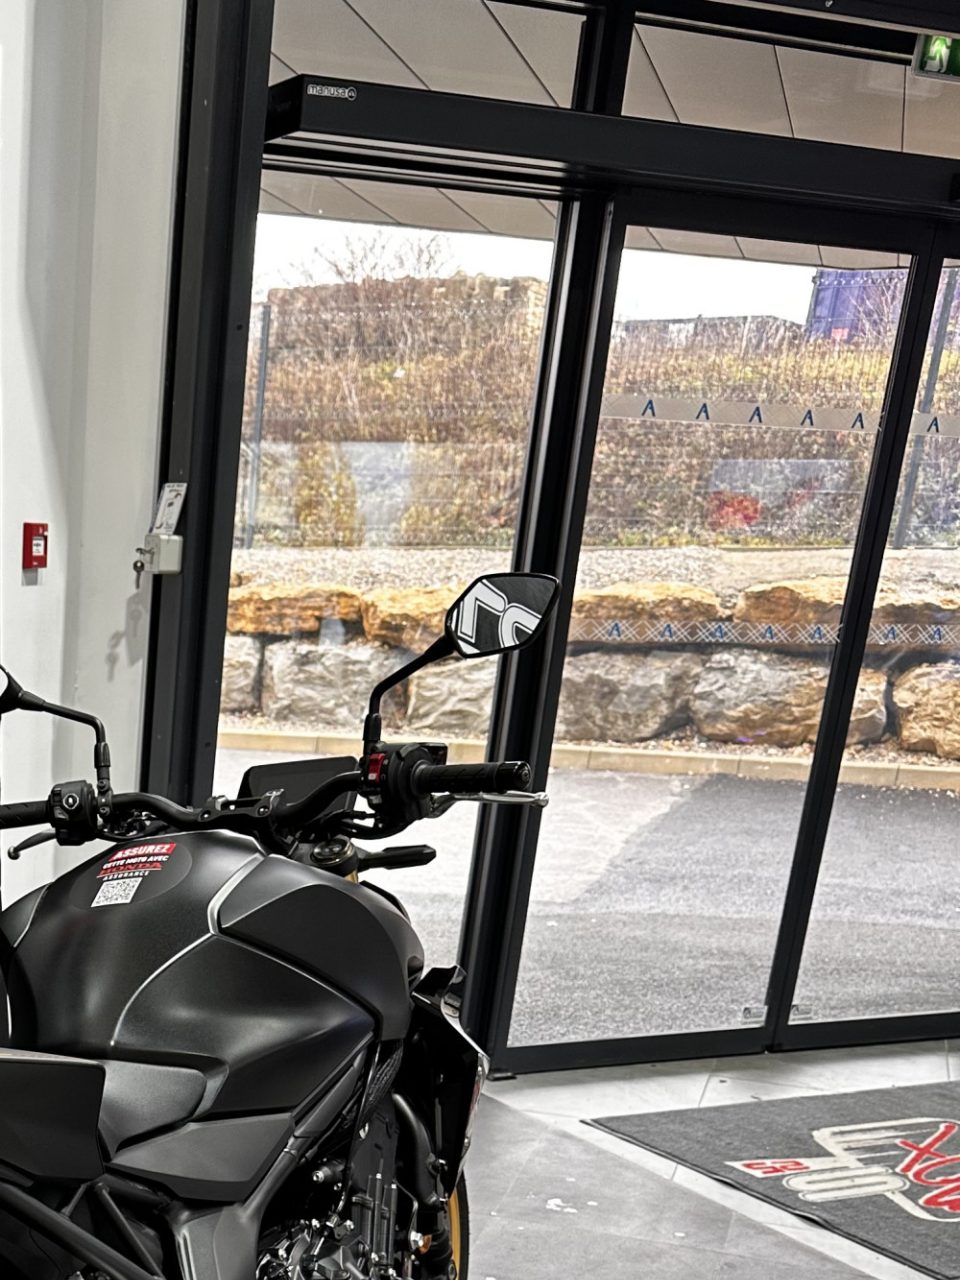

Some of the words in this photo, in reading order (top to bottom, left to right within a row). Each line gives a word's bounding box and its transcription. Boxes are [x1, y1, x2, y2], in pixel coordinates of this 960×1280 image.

[111, 845, 171, 860] ASSUREZ
[100, 862, 162, 875] HONDA
[102, 860, 126, 870] CETTE
[126, 856, 148, 865] MOTO
[102, 870, 150, 881] ASSURANCE
